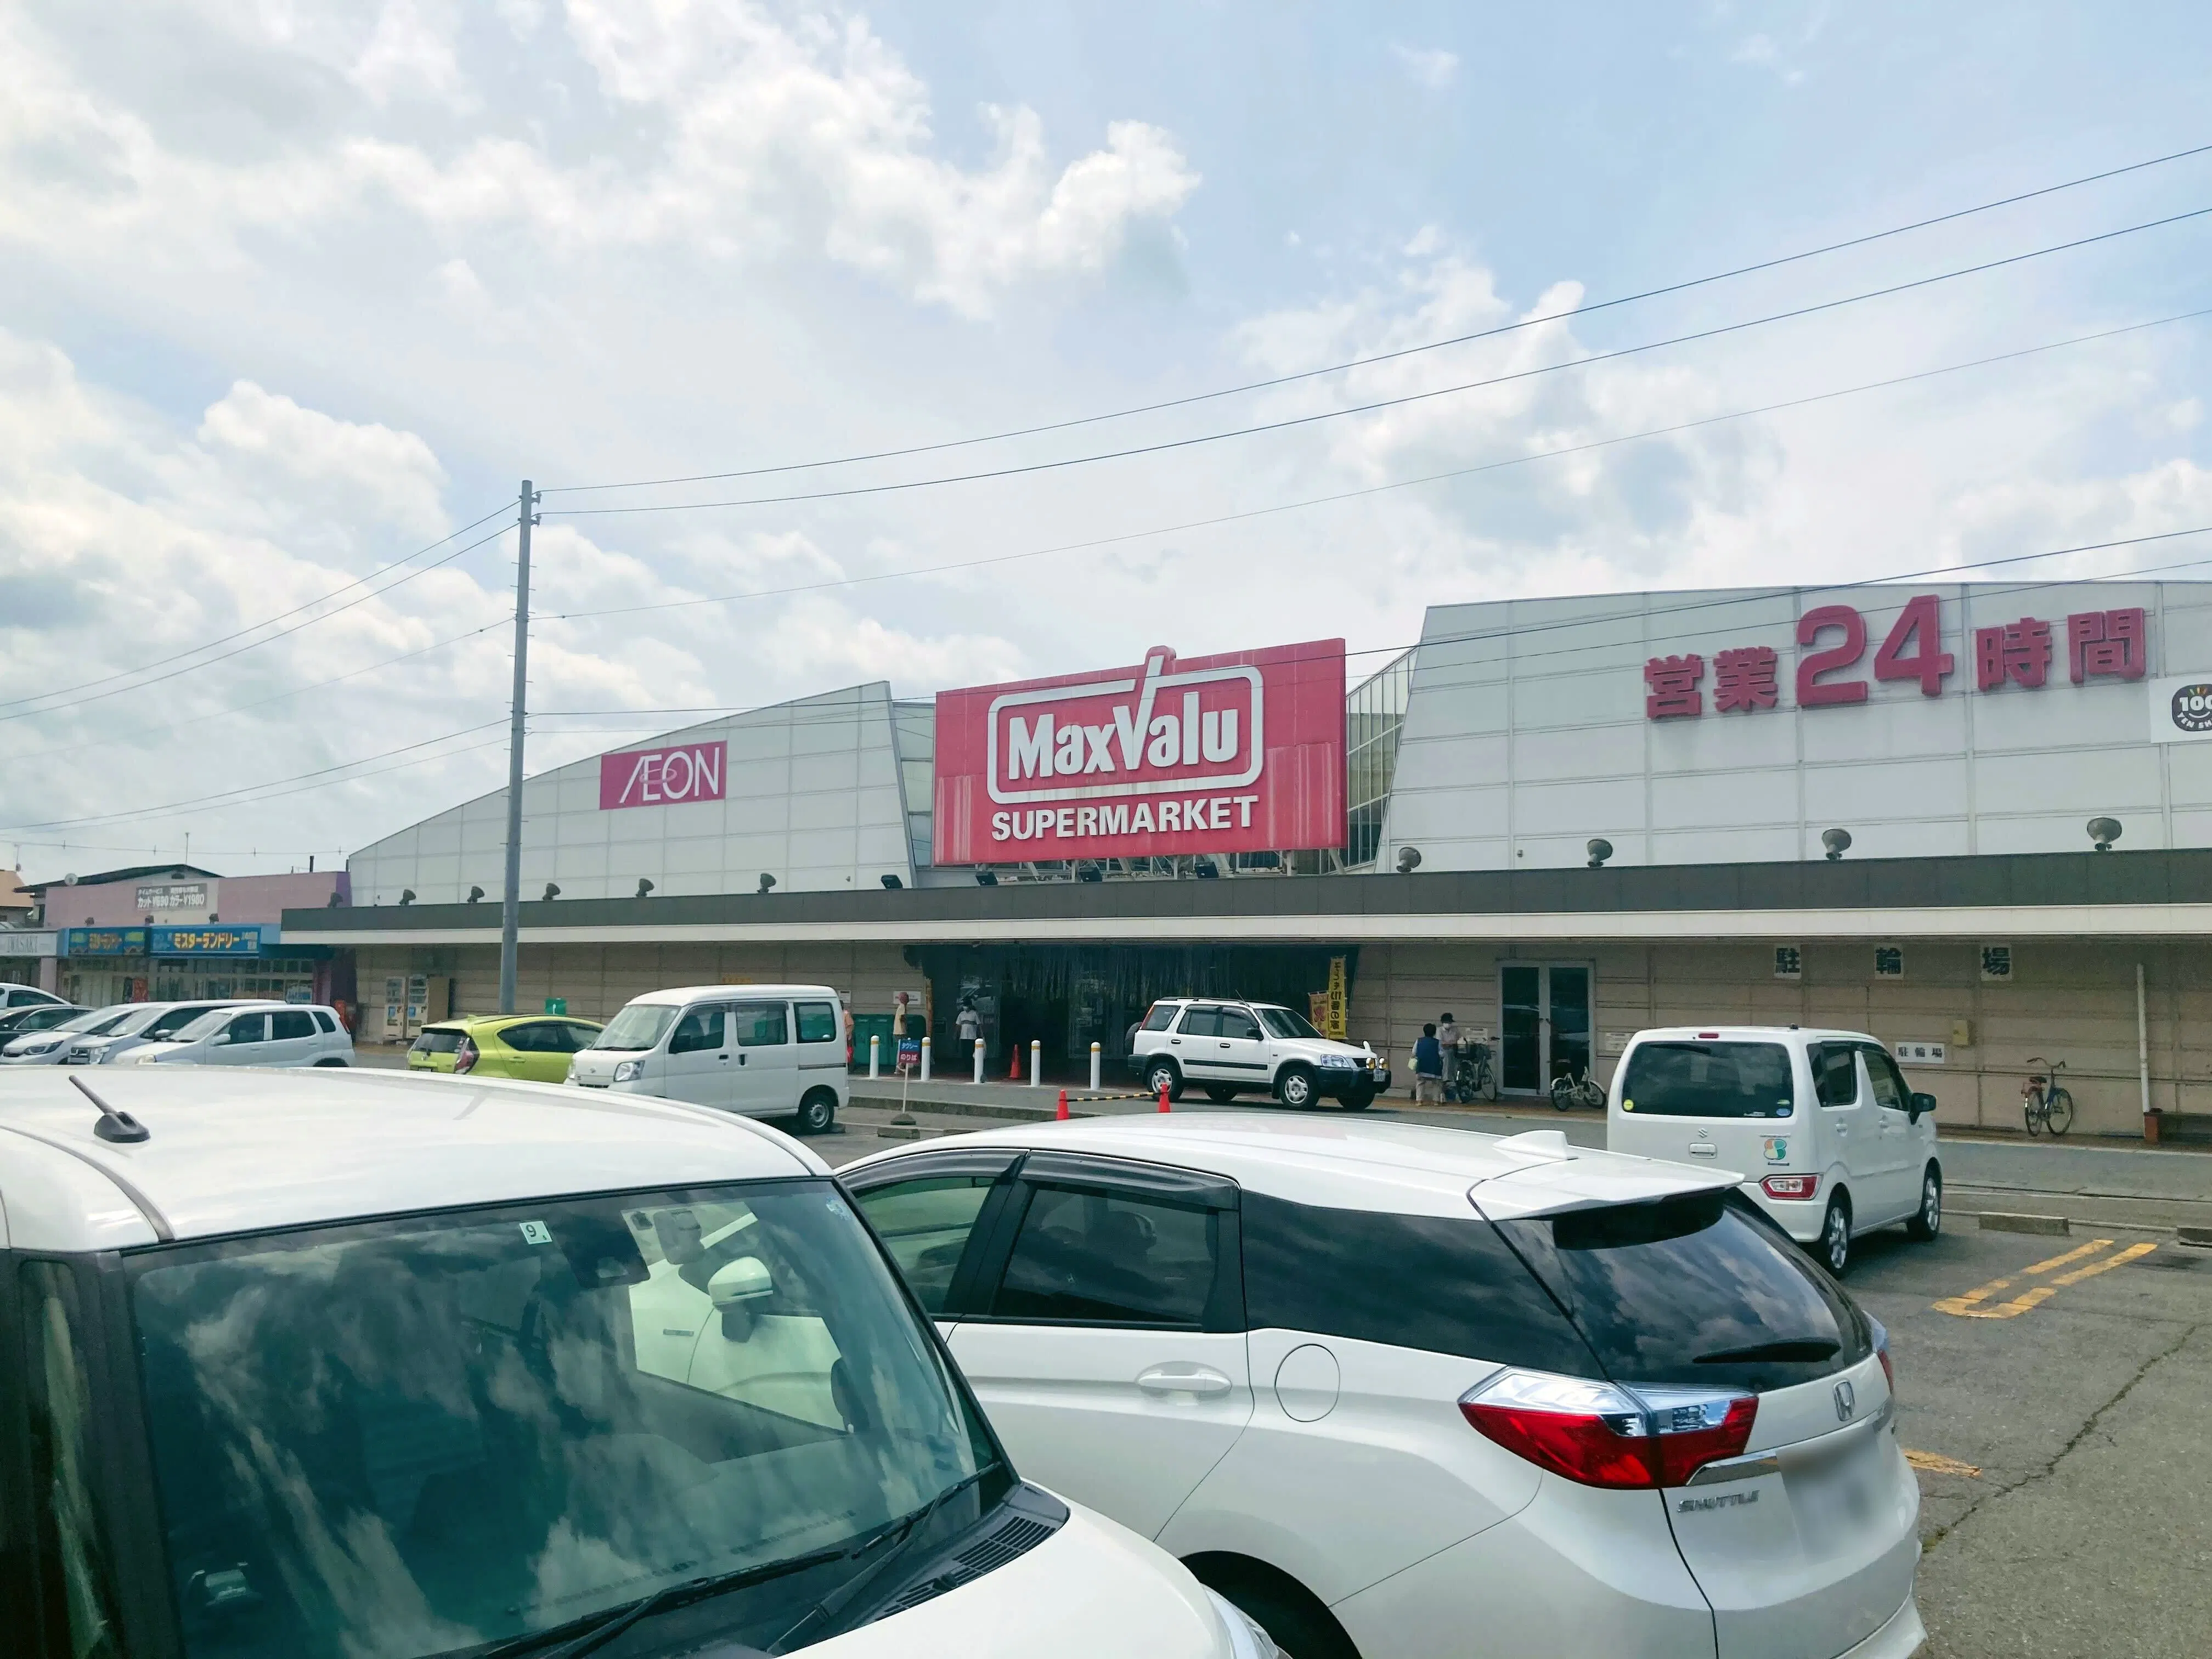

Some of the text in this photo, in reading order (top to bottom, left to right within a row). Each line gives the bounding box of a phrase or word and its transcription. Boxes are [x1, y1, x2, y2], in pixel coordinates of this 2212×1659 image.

[1644, 594, 2146, 719] 営業24時間
[1008, 655, 1239, 780] MaxValu
[2177, 712, 2195, 728] YEN
[991, 794, 1259, 842] SUPERMARKET
[174, 932, 240, 949] ミスターランドリー
[526, 1224, 537, 1238] 9
[1677, 1489, 1760, 1513] SHUTTLE
